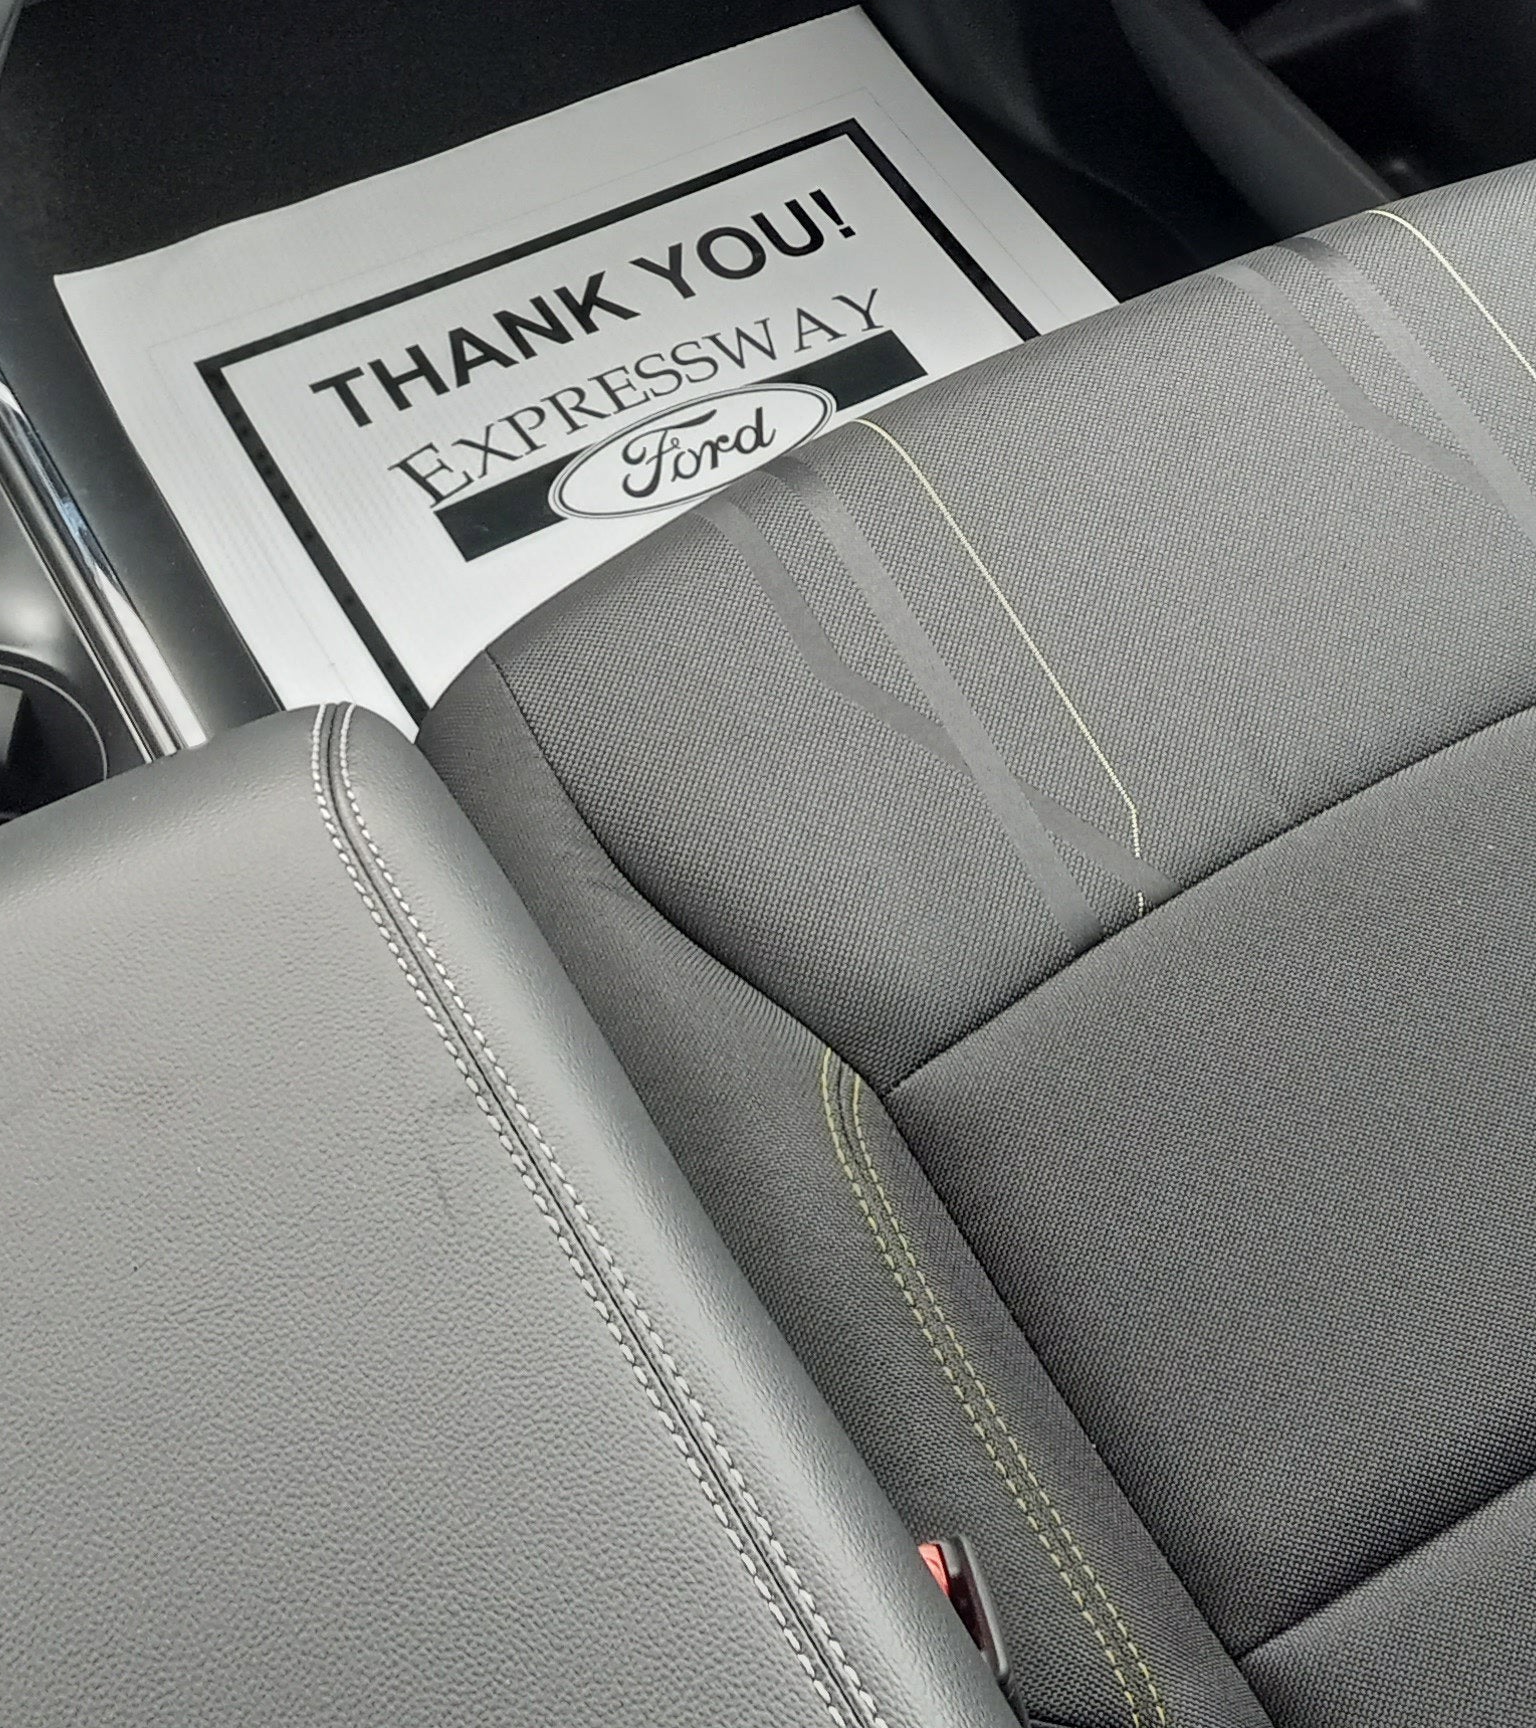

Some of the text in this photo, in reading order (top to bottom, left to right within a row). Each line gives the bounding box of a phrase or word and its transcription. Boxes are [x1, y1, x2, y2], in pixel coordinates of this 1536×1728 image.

[309, 188, 857, 429] THANK YOU!
[386, 287, 886, 509] EXPRESSWAY
[621, 406, 777, 500] Ford
